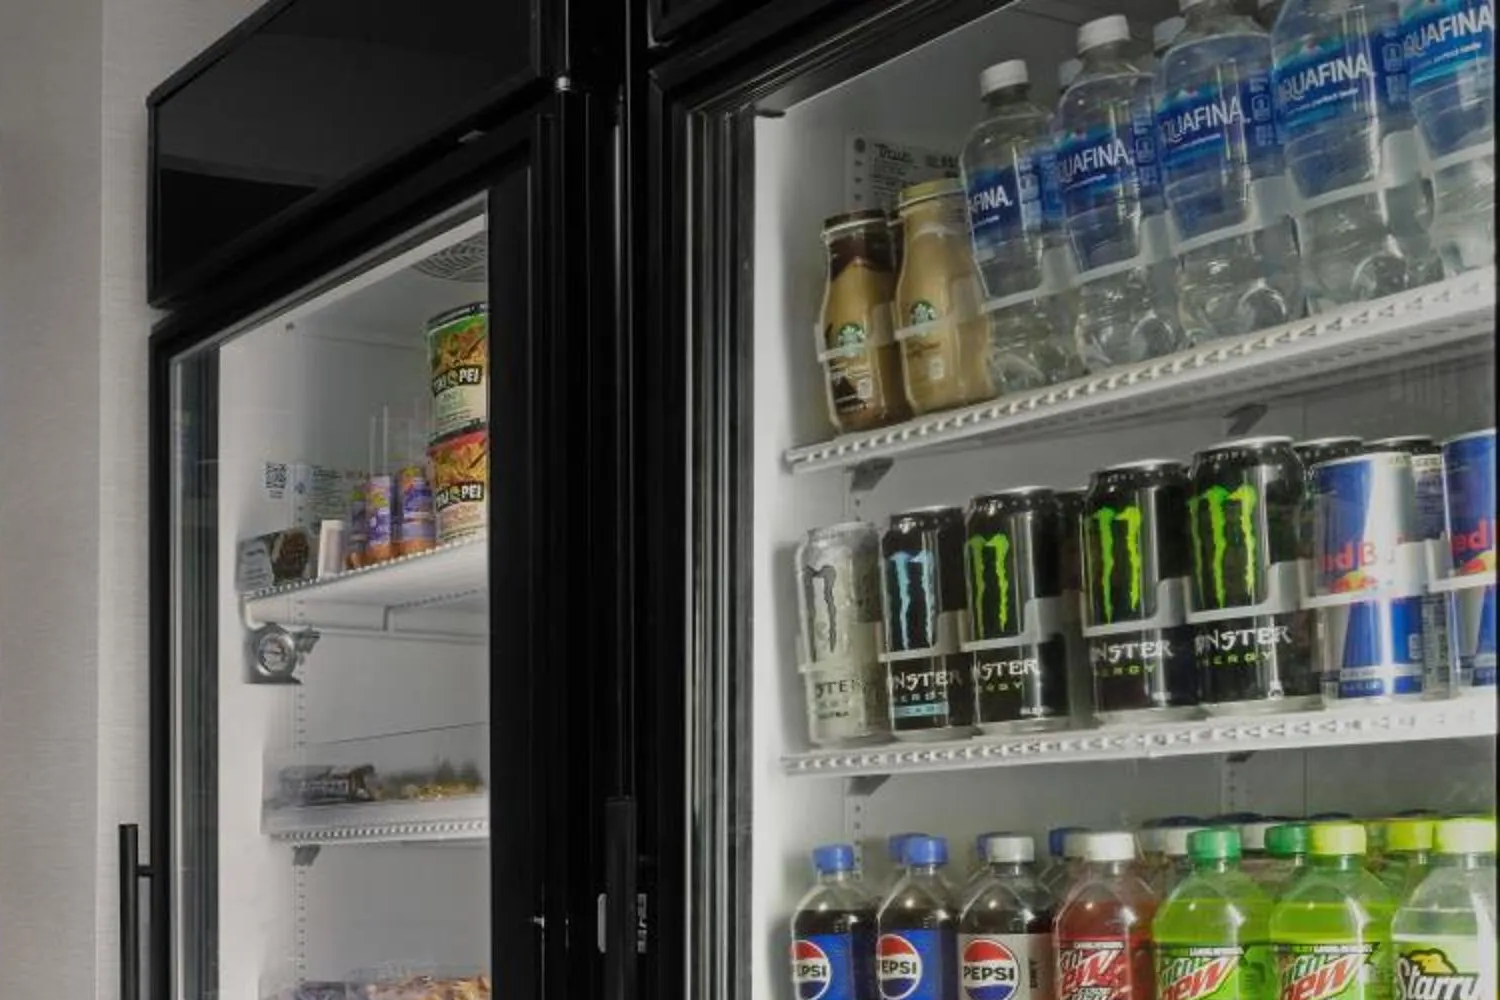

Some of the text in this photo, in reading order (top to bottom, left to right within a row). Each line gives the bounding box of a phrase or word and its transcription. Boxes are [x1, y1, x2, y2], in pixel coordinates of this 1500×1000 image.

[459, 367, 479, 383] PEI
[461, 484, 481, 499] PEI
[882, 960, 917, 975] EPSI
[963, 965, 1015, 981] PEPSI
